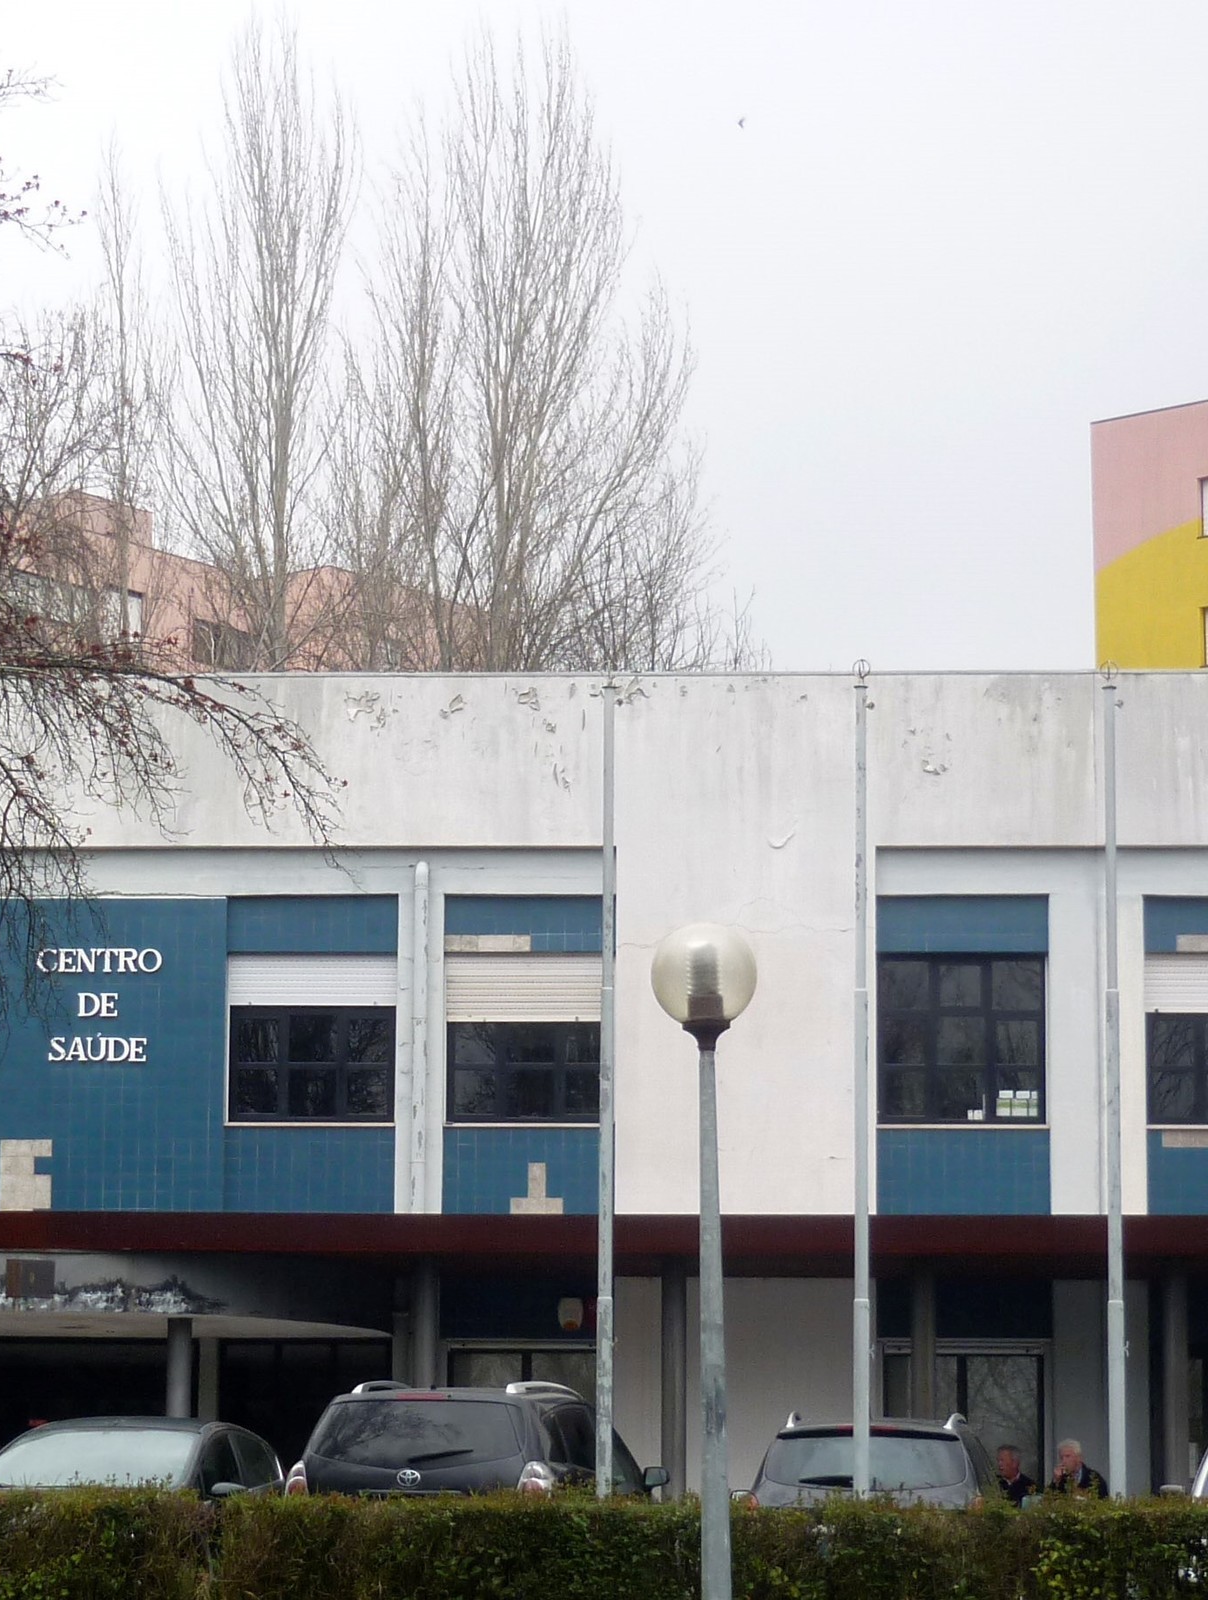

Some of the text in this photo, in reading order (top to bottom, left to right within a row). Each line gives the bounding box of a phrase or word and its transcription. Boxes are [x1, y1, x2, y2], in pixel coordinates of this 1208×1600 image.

[36, 948, 163, 973] CENTRO
[77, 992, 118, 1017] DE
[48, 1032, 147, 1062] SAÚDE
